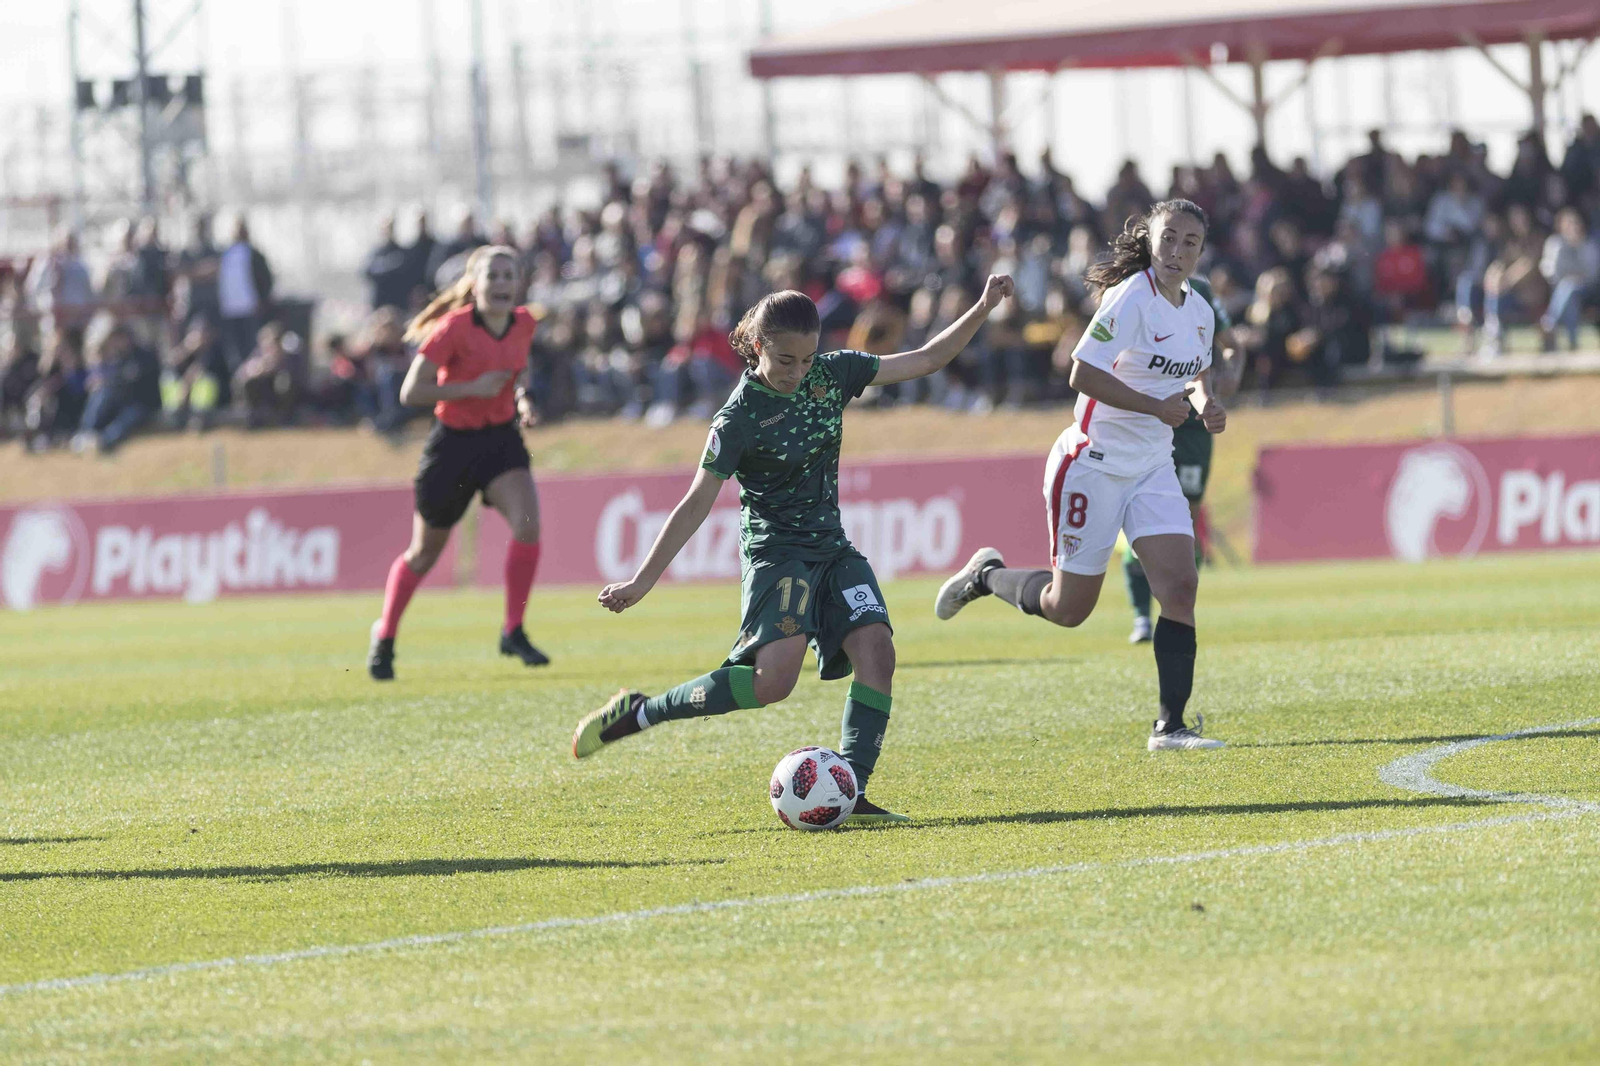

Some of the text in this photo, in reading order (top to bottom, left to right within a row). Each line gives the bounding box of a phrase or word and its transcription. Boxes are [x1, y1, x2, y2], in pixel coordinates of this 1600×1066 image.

[759, 412, 785, 428] Kappa
[1066, 492, 1089, 529] 8
[92, 506, 340, 604] Playtika
[776, 576, 810, 616] 17
